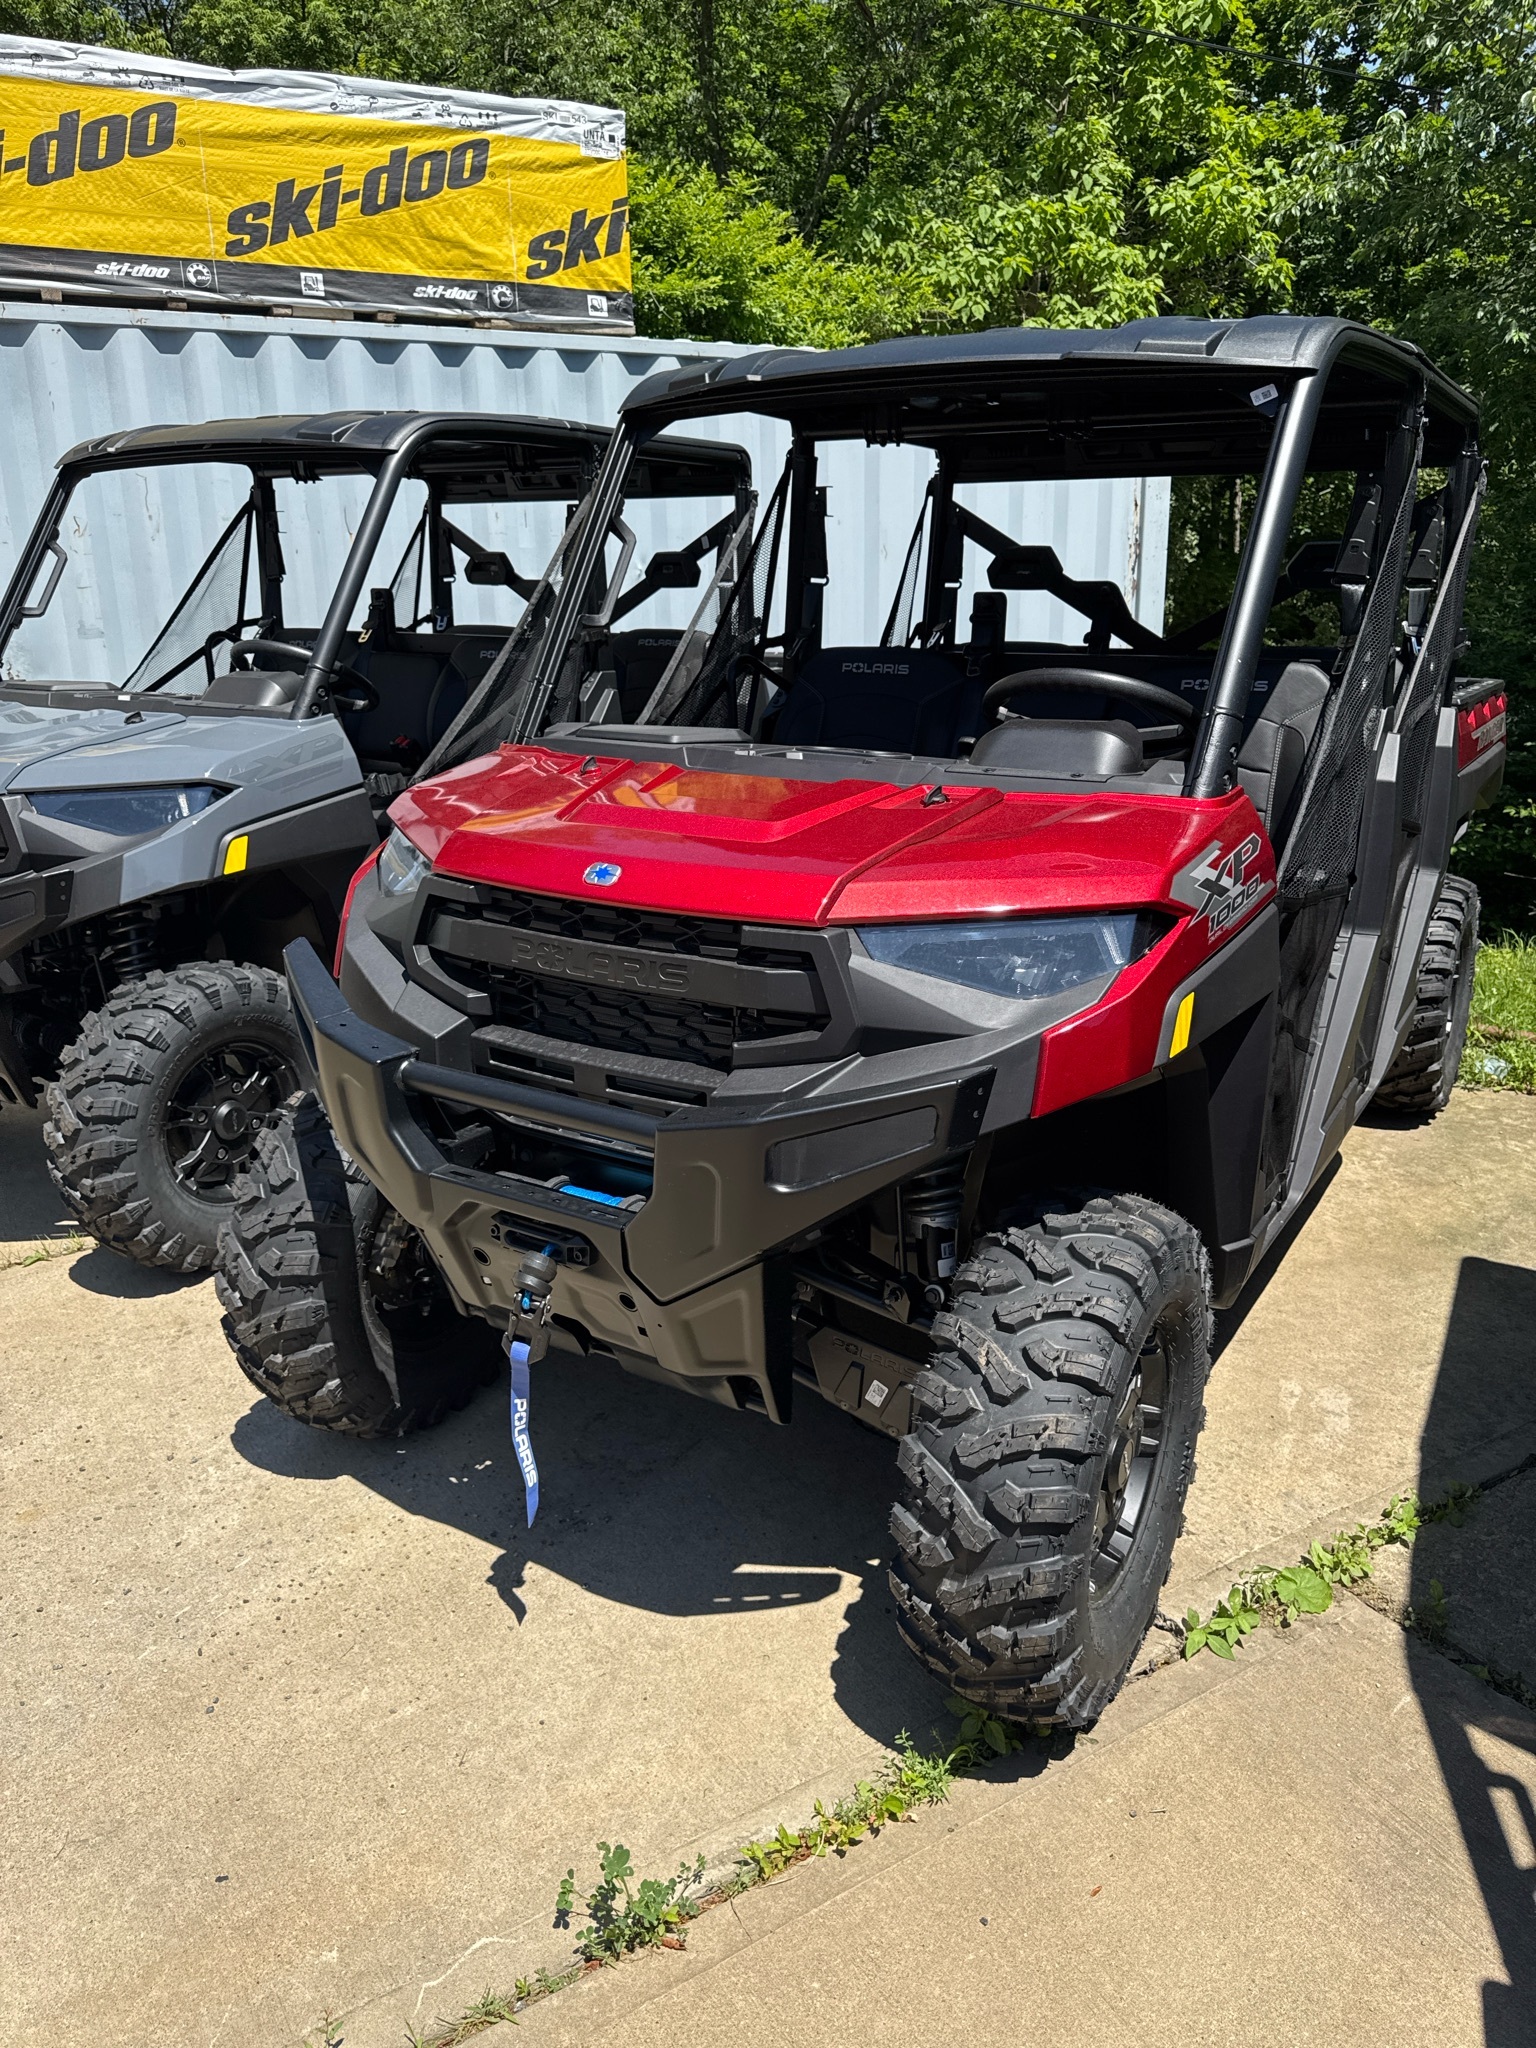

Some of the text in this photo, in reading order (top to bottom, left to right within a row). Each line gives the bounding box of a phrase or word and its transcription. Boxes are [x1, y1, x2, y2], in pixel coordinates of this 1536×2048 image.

[0, 101, 178, 187] -doo
[571, 115, 587, 125] 543
[225, 138, 491, 257] ski-doo
[94, 262, 171, 279] ski-doo
[413, 284, 478, 301] ski-doo
[841, 662, 910, 675] POLARIS
[1187, 832, 1262, 930] XP
[1208, 873, 1261, 939] 1000
[511, 935, 690, 993] POLARIS
[831, 1336, 918, 1379] POLARIS
[513, 1398, 537, 1488] POLARIS
